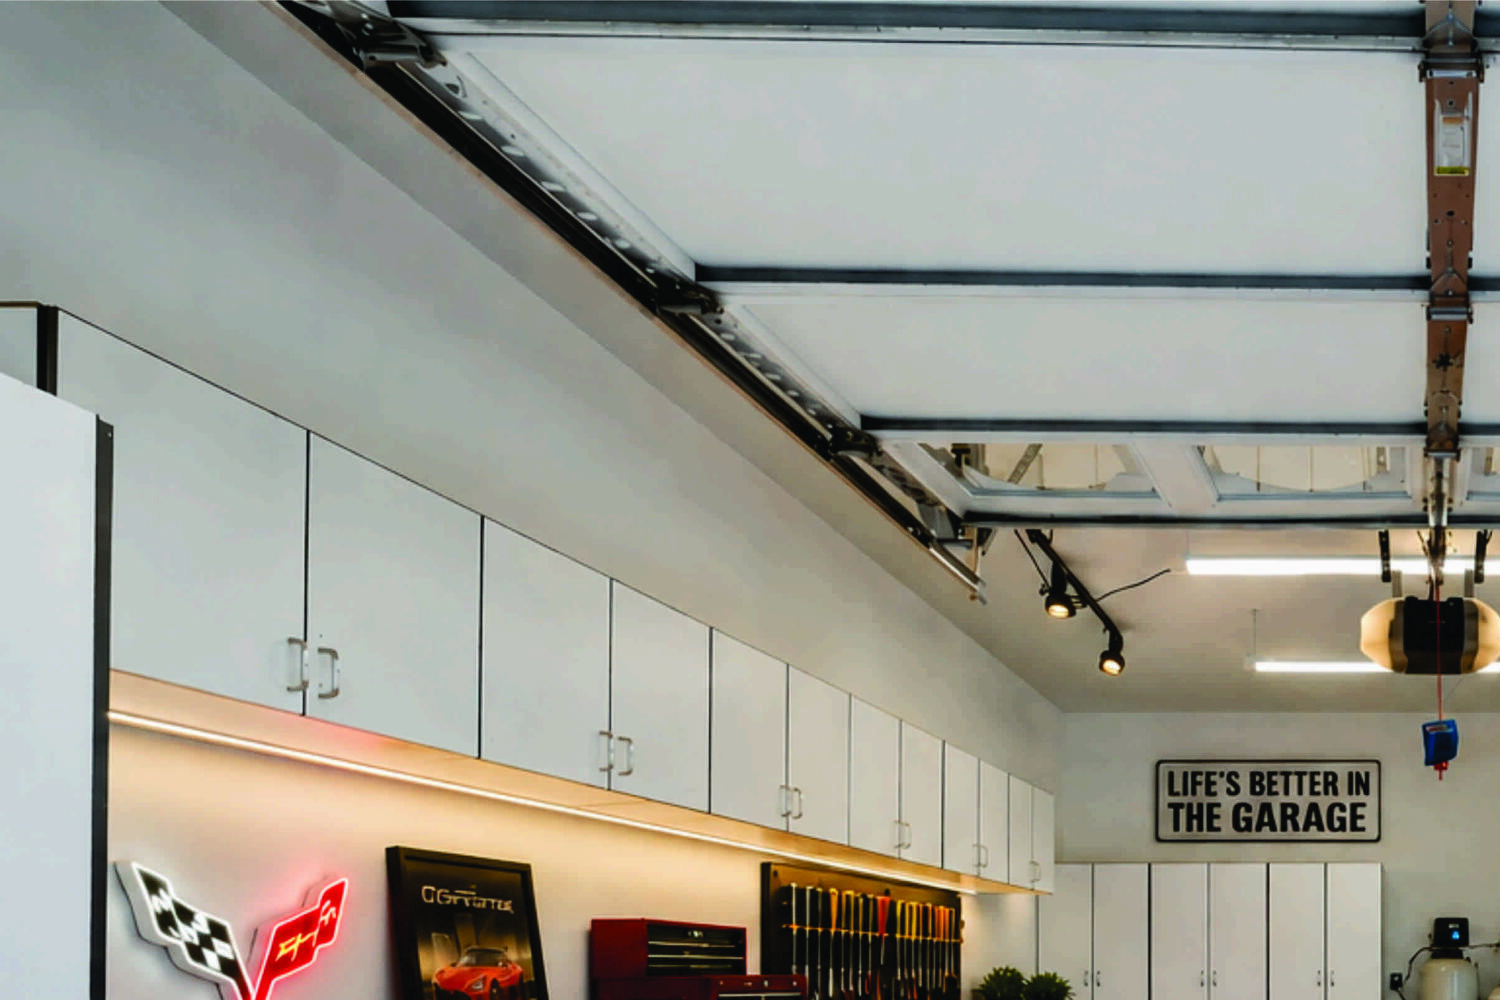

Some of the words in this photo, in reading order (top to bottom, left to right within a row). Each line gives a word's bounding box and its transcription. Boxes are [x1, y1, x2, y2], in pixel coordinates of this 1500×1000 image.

[1168, 771, 1241, 797] LIFE'S
[1250, 771, 1339, 796] BETTER
[1348, 771, 1370, 796] IN
[1168, 802, 1222, 832] THE
[1232, 802, 1366, 832] GARAGE
